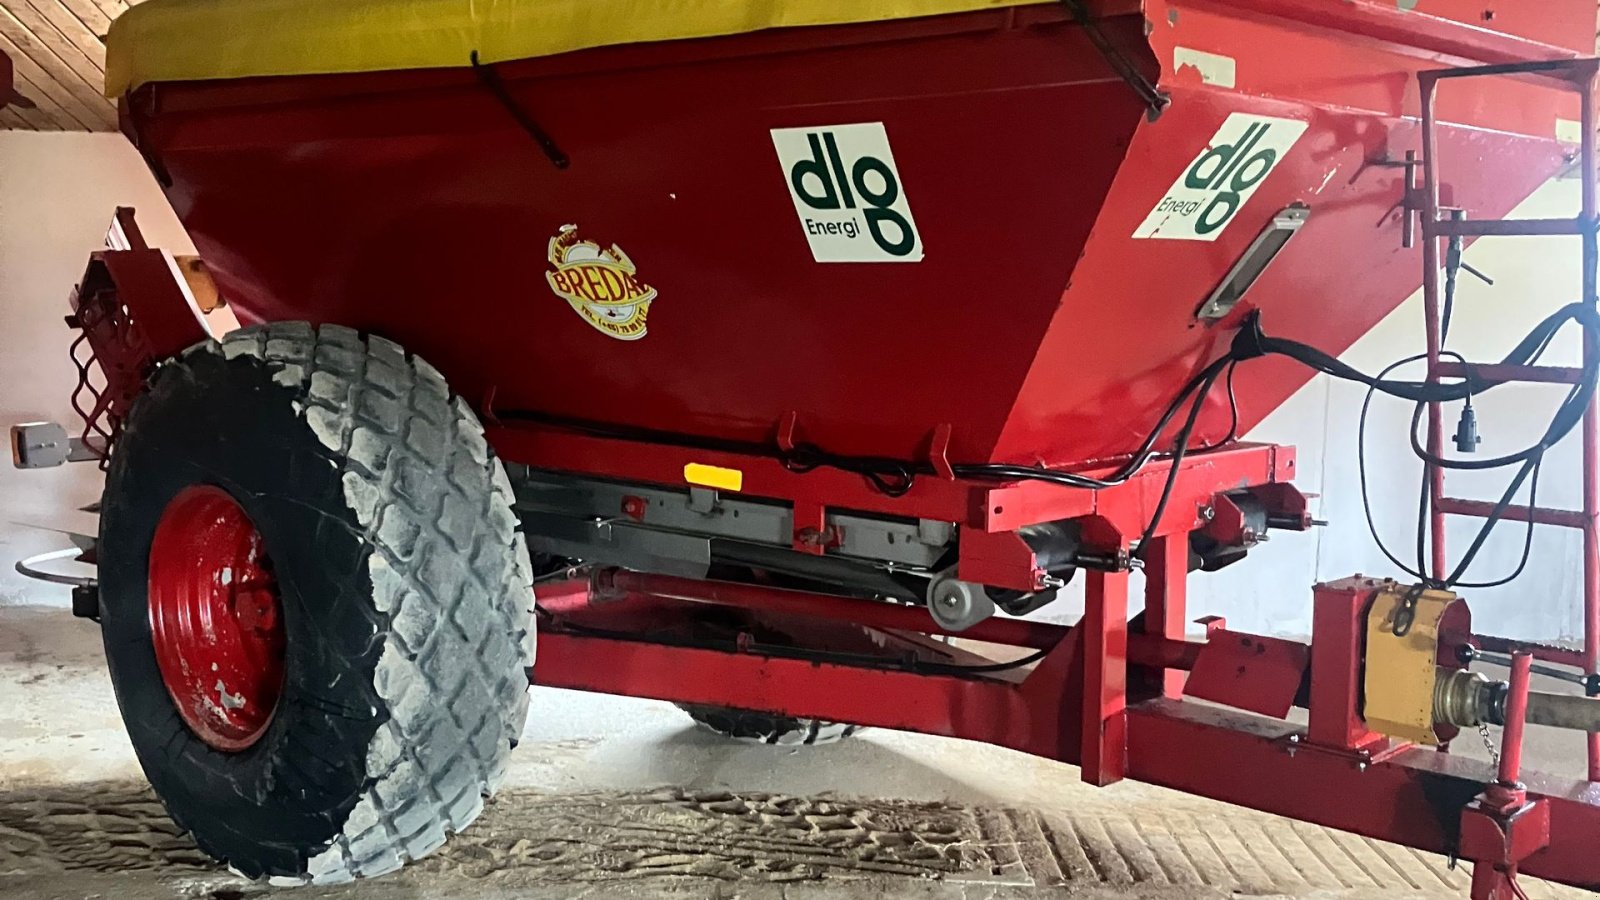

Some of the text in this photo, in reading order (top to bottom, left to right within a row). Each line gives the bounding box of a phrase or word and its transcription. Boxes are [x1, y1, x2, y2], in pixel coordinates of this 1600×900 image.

[791, 131, 915, 256] dlg
[1156, 196, 1206, 217] Energi
[1184, 122, 1277, 235] dlg
[805, 217, 861, 239] Energi
